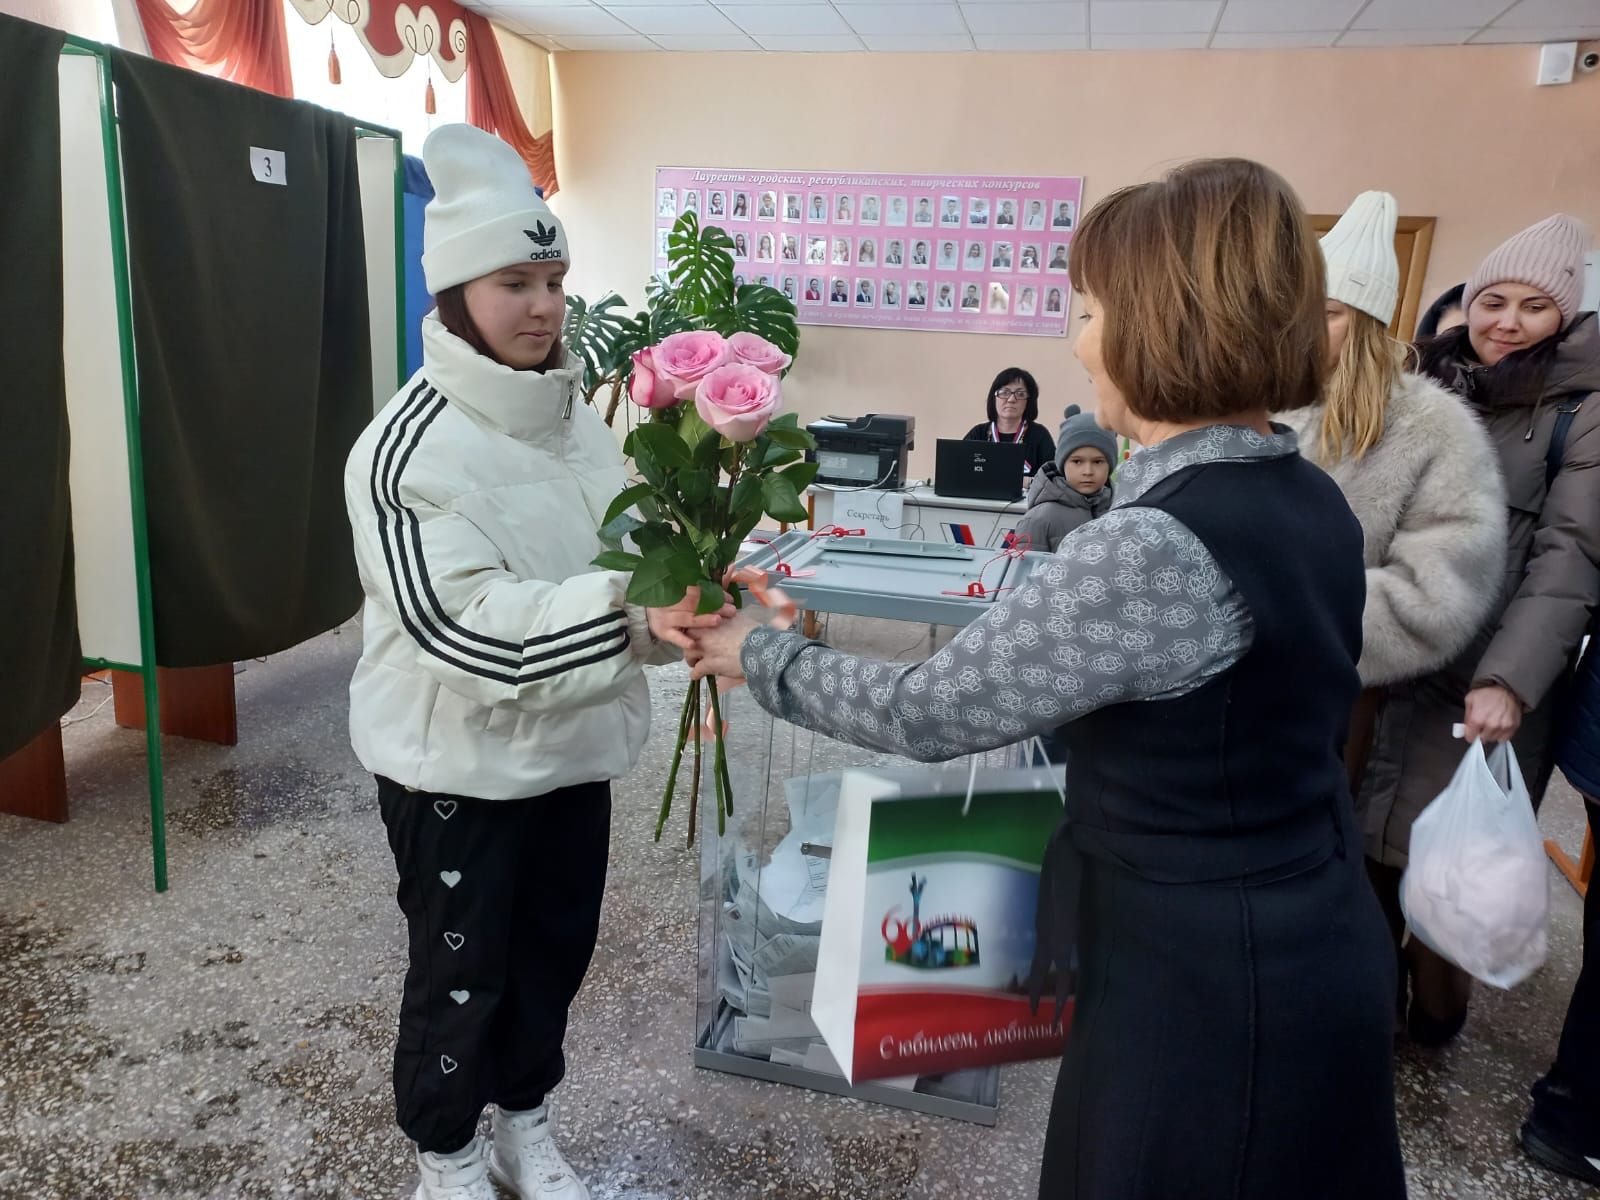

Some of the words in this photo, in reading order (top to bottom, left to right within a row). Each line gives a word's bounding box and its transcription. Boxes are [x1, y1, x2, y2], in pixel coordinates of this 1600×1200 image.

[264, 156, 272, 178] 3
[692, 171, 745, 184] Лауреаты
[748, 174, 806, 186] городских,
[808, 175, 907, 188] республиканских,
[911, 178, 978, 190] творческих
[982, 180, 1041, 192] конкурсов
[530, 248, 562, 261] adidas
[846, 509, 890, 523] Секретарь
[879, 1034, 894, 1060] С
[899, 1029, 978, 1057] юбилеем,
